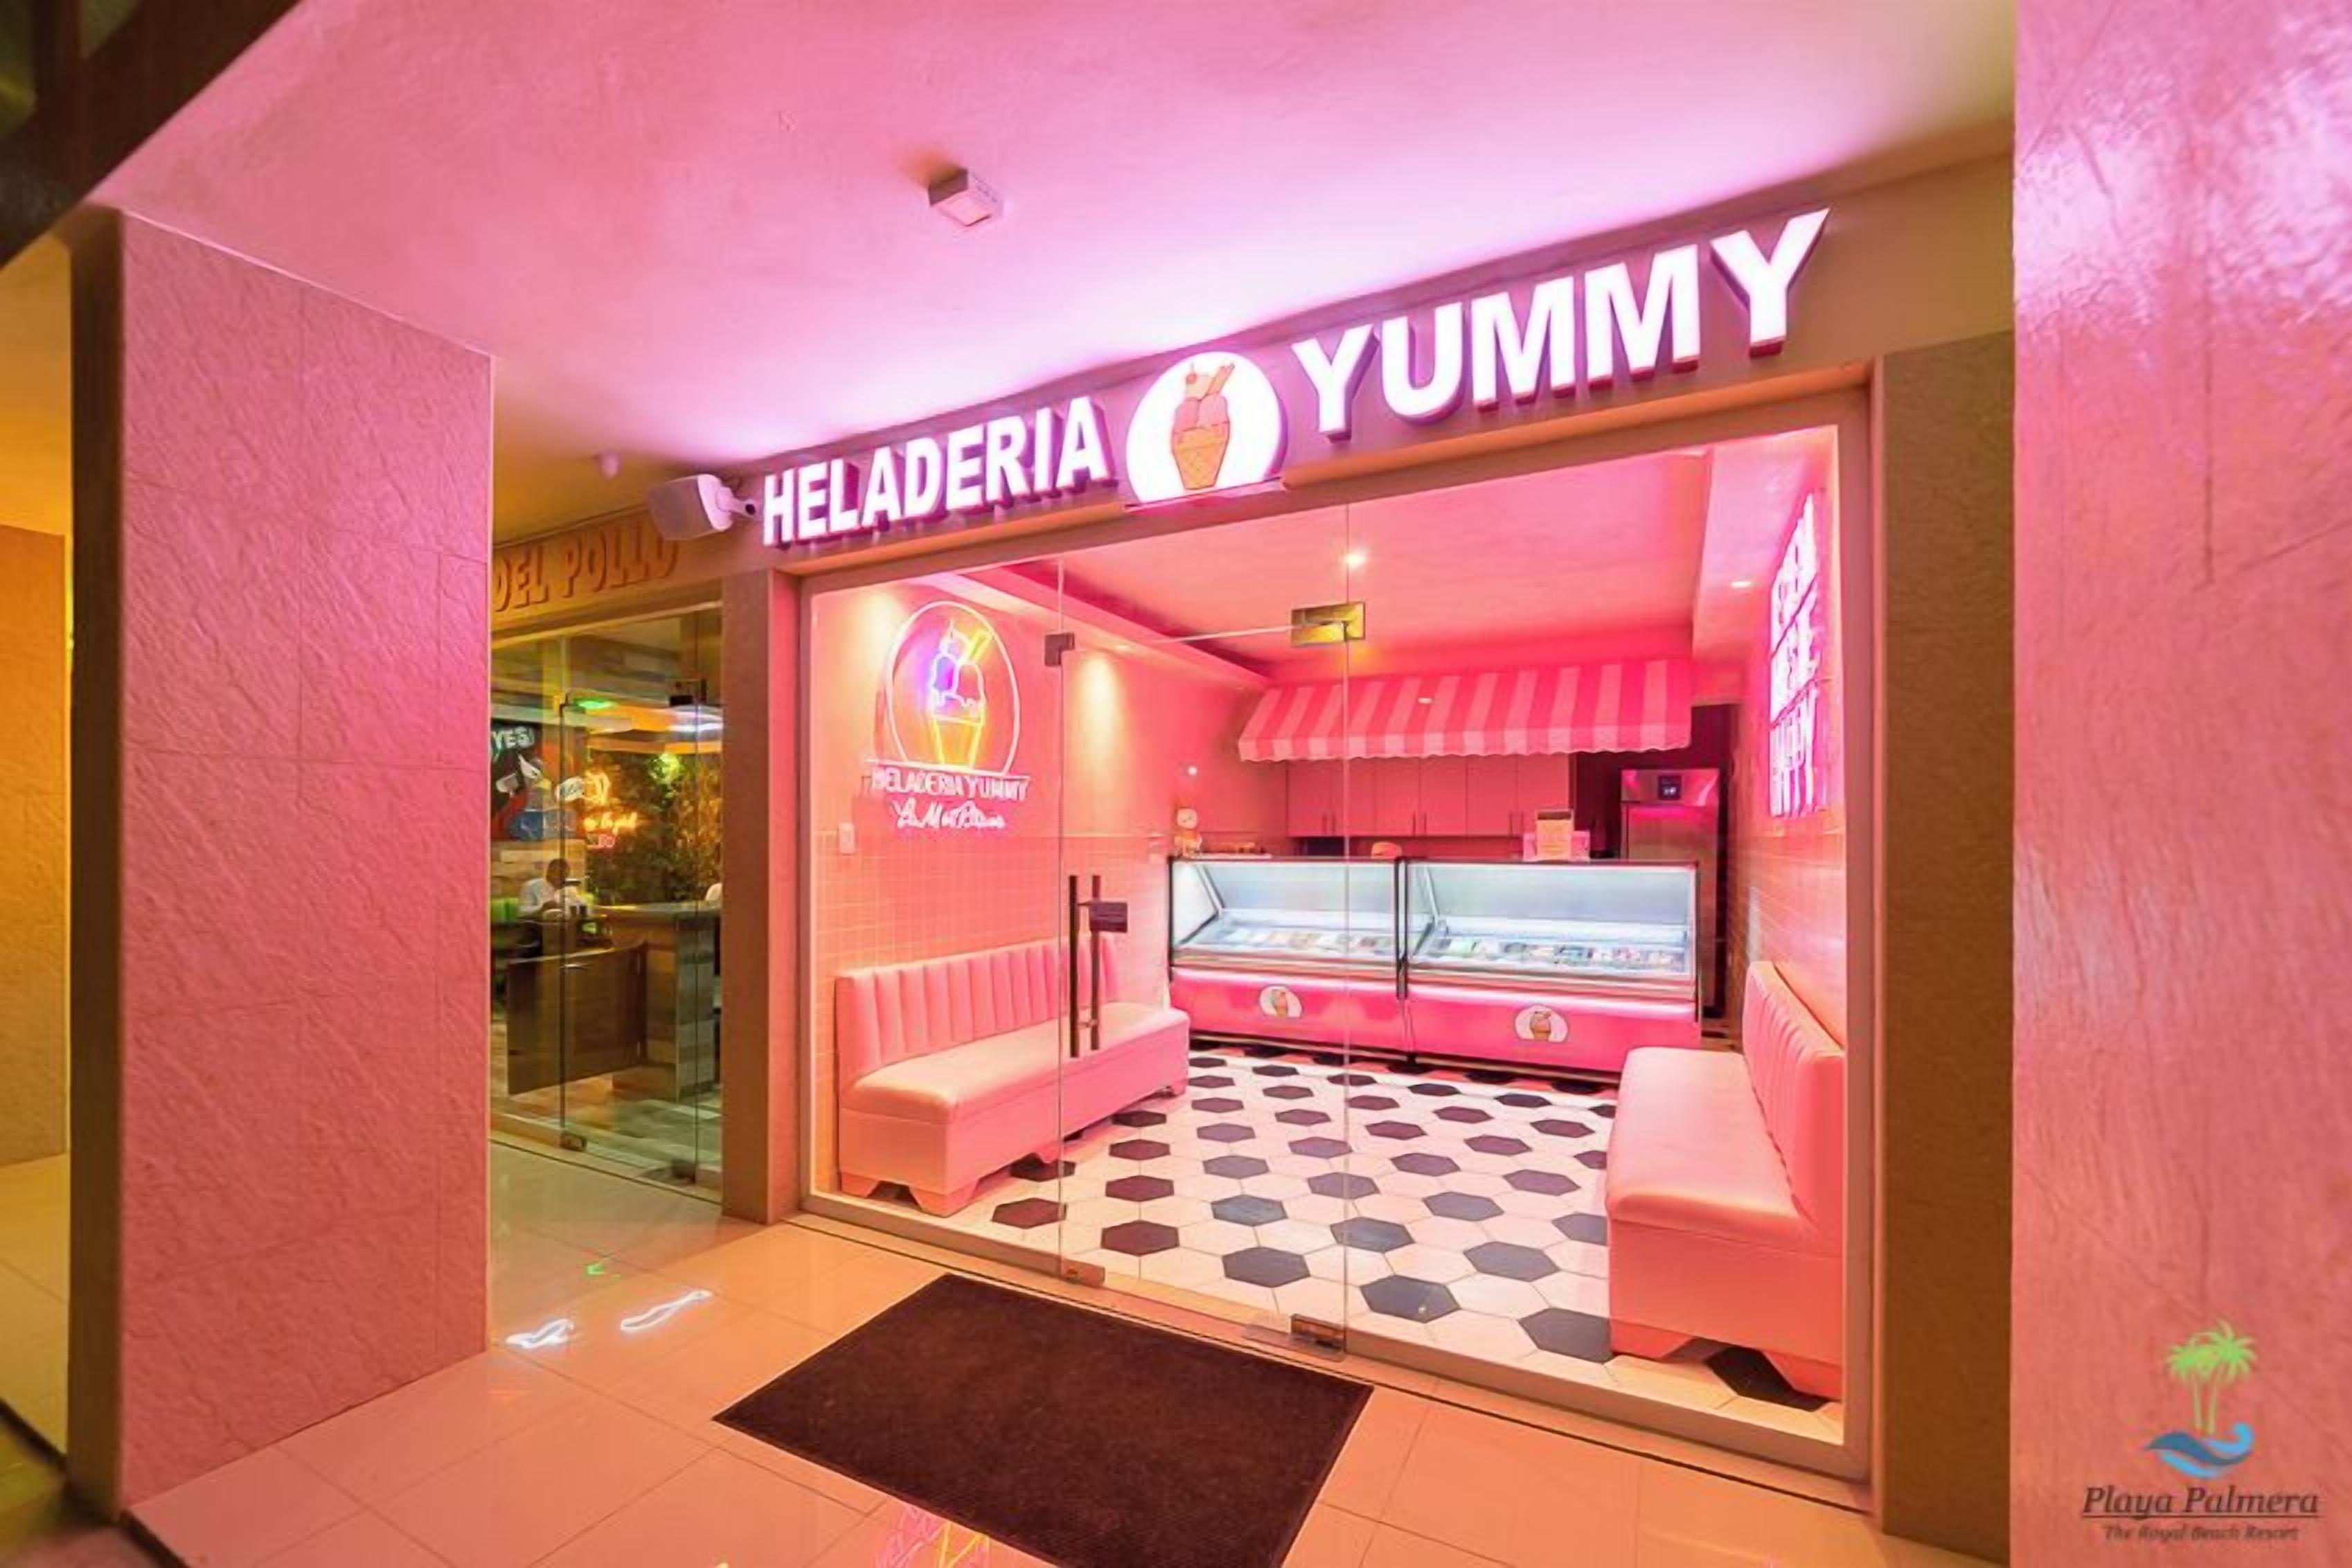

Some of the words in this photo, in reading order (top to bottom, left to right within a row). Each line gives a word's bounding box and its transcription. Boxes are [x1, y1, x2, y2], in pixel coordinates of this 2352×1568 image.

[763, 395, 1114, 548] HELADERIA
[1291, 207, 1830, 439] YUMMY
[564, 521, 679, 598] POLLO
